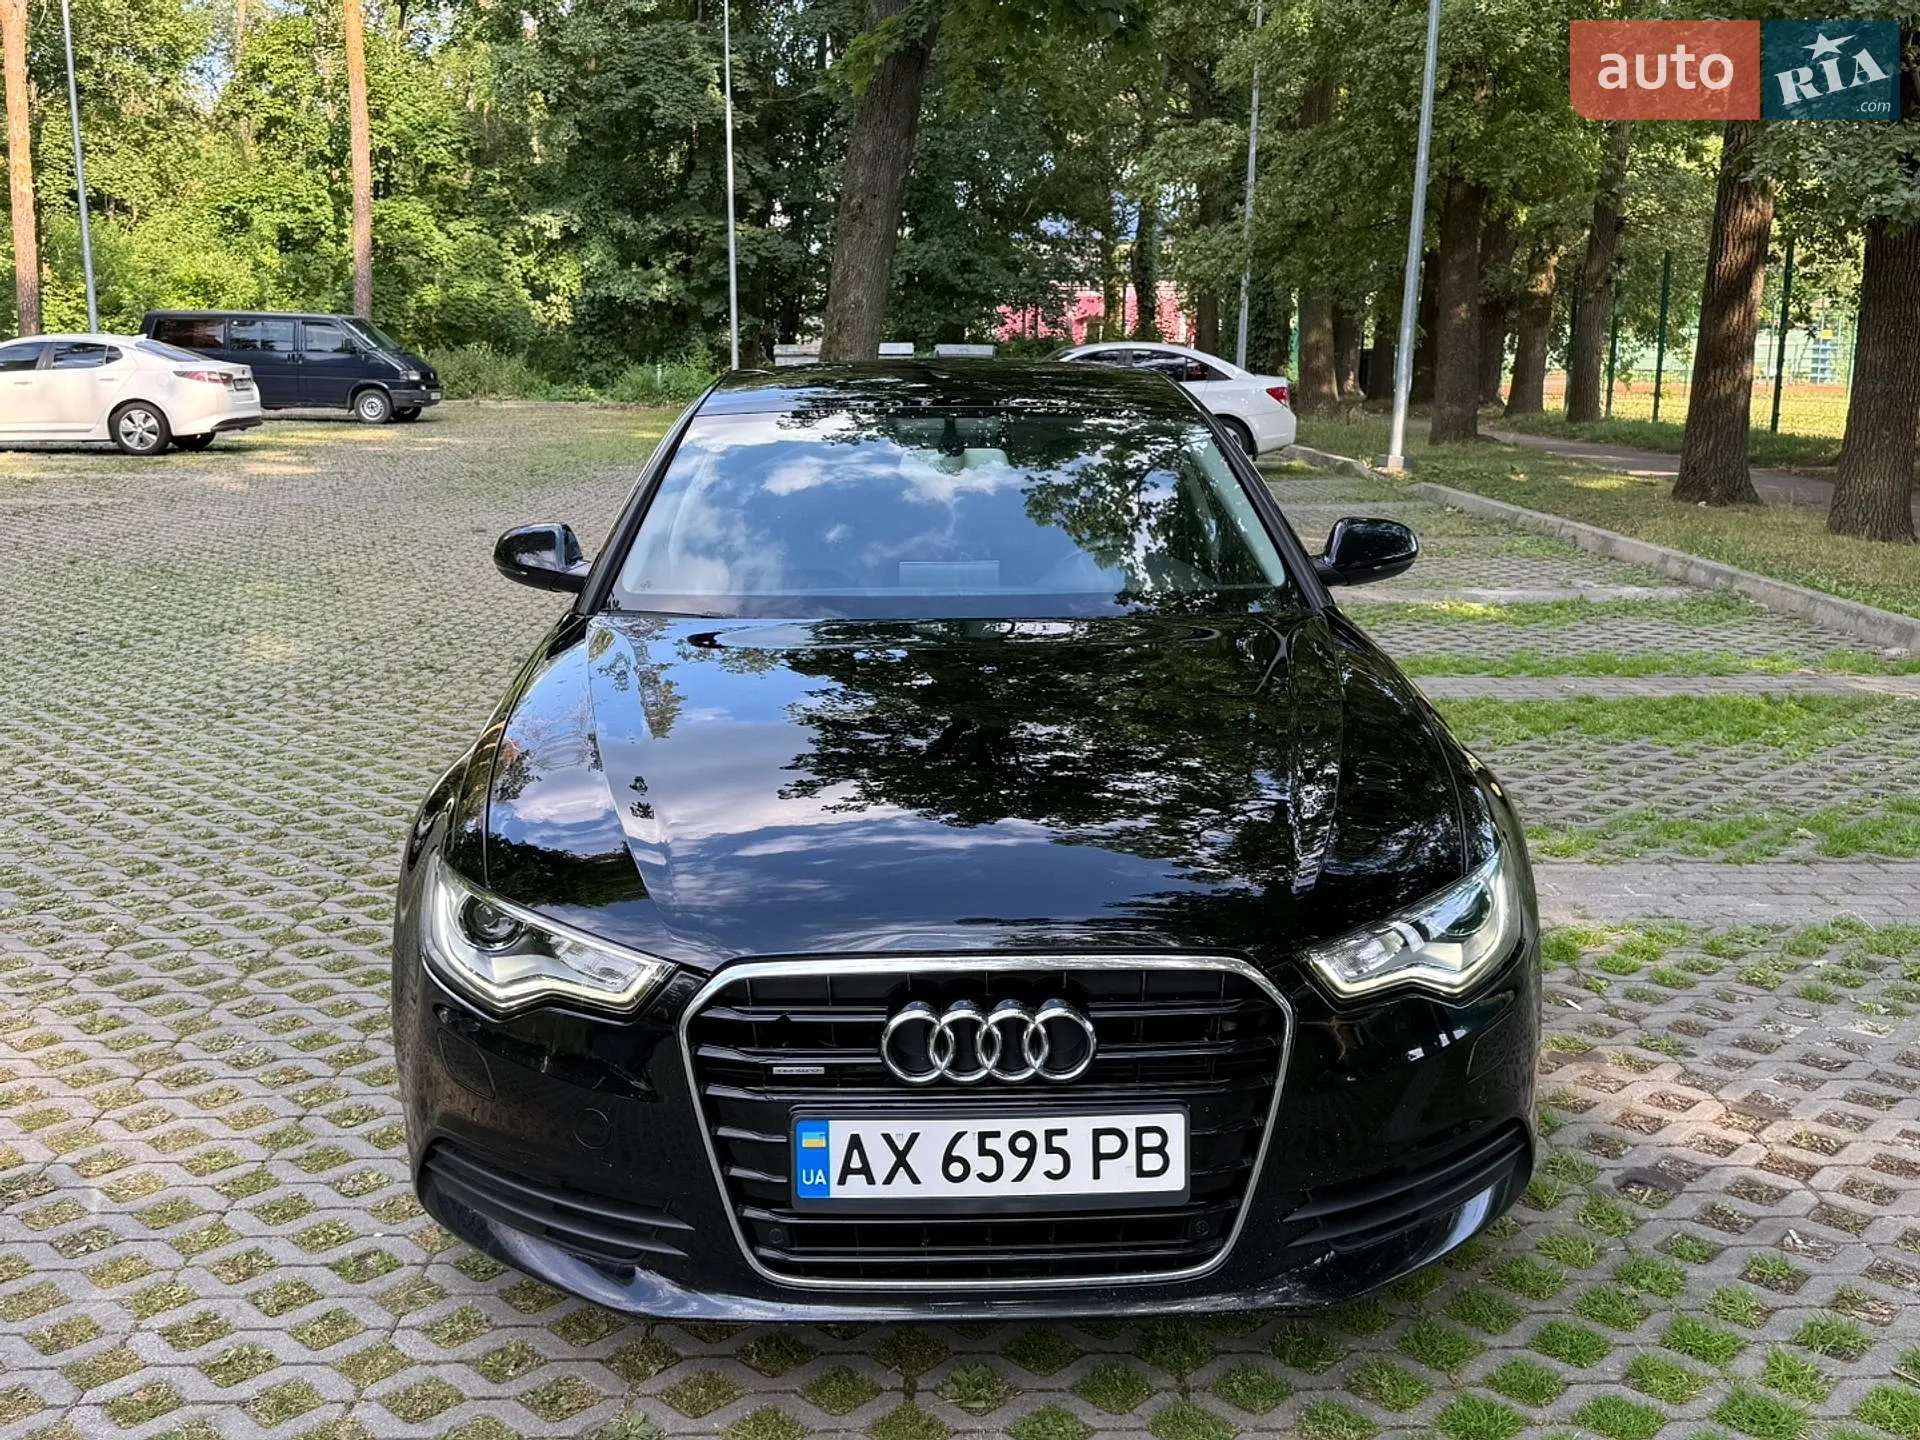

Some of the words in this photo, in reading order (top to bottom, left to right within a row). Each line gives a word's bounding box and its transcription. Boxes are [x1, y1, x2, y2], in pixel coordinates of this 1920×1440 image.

[837, 1132, 922, 1186] AX
[941, 1127, 1072, 1183] 6595
[1092, 1125, 1170, 1180] PB
[802, 1169, 827, 1185] UA
